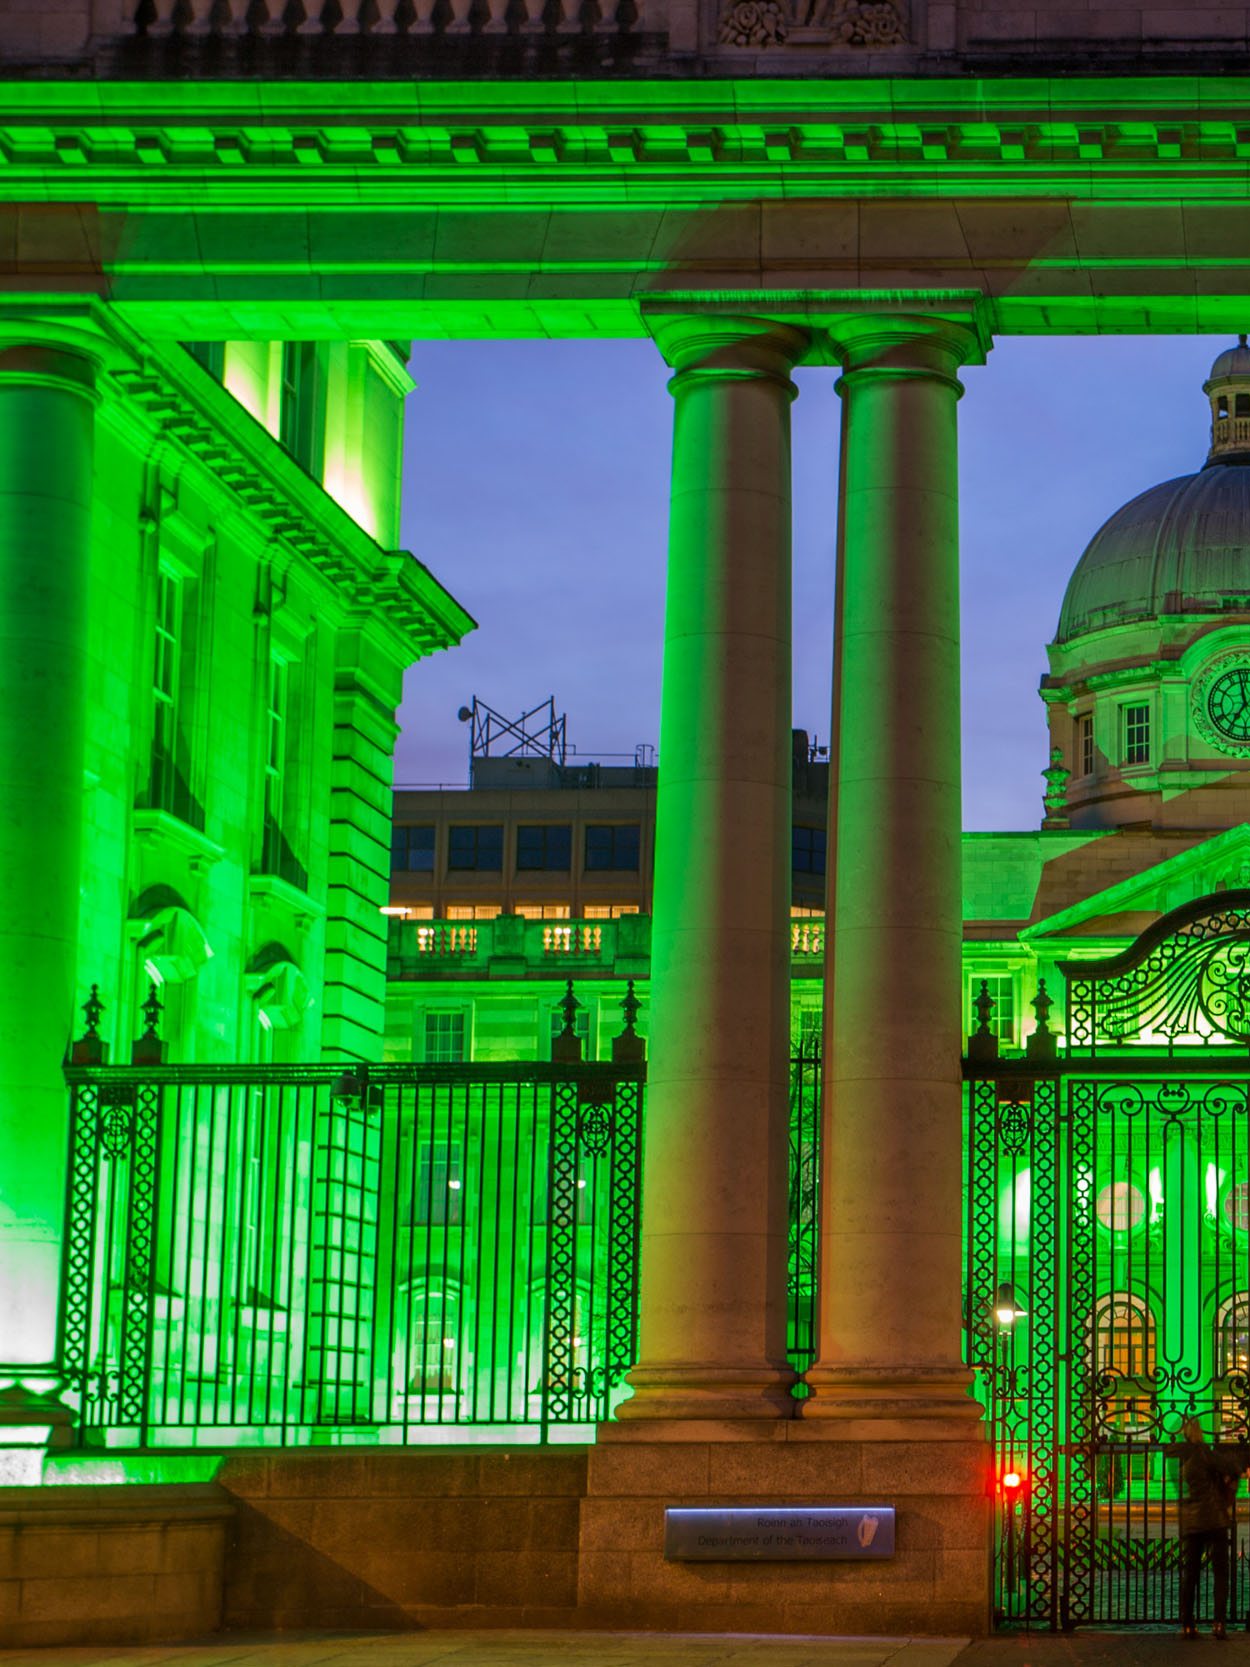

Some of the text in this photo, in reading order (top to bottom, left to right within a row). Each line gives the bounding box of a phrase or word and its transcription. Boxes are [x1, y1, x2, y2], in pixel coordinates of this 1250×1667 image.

[757, 1518, 848, 1528] Roinn an Taoisigh
[698, 1536, 848, 1546] Department of the Taoiseach
